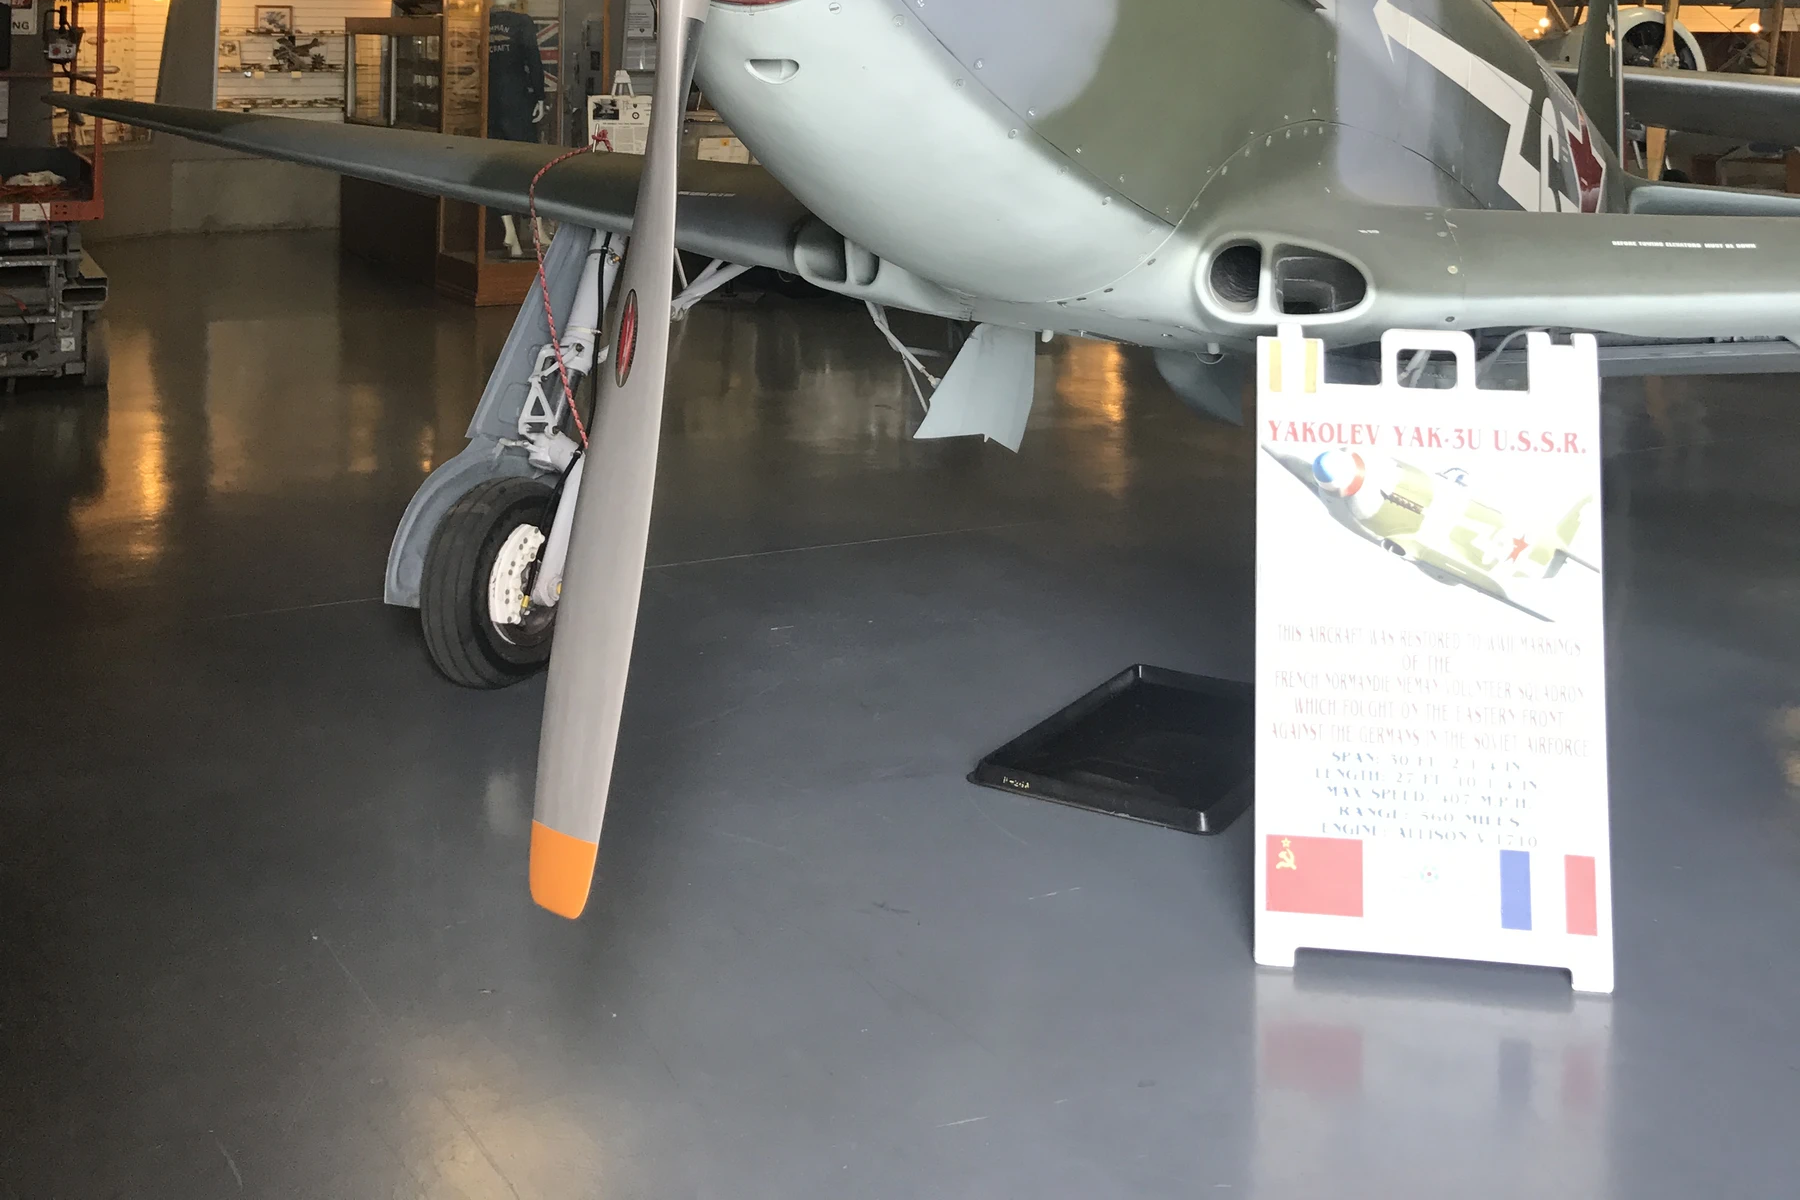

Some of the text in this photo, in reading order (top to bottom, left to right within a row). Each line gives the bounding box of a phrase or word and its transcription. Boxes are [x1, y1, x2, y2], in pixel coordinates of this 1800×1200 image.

[1268, 420, 1587, 454] YAKOLEV YAK-3U U.S.S.R.
[1278, 624, 1303, 642] THIS
[1401, 653, 1453, 674] OF THE
[1294, 697, 1337, 716] WHICH
[1426, 703, 1449, 722] THE
[1331, 724, 1354, 743] THE
[1445, 730, 1467, 749] THE
